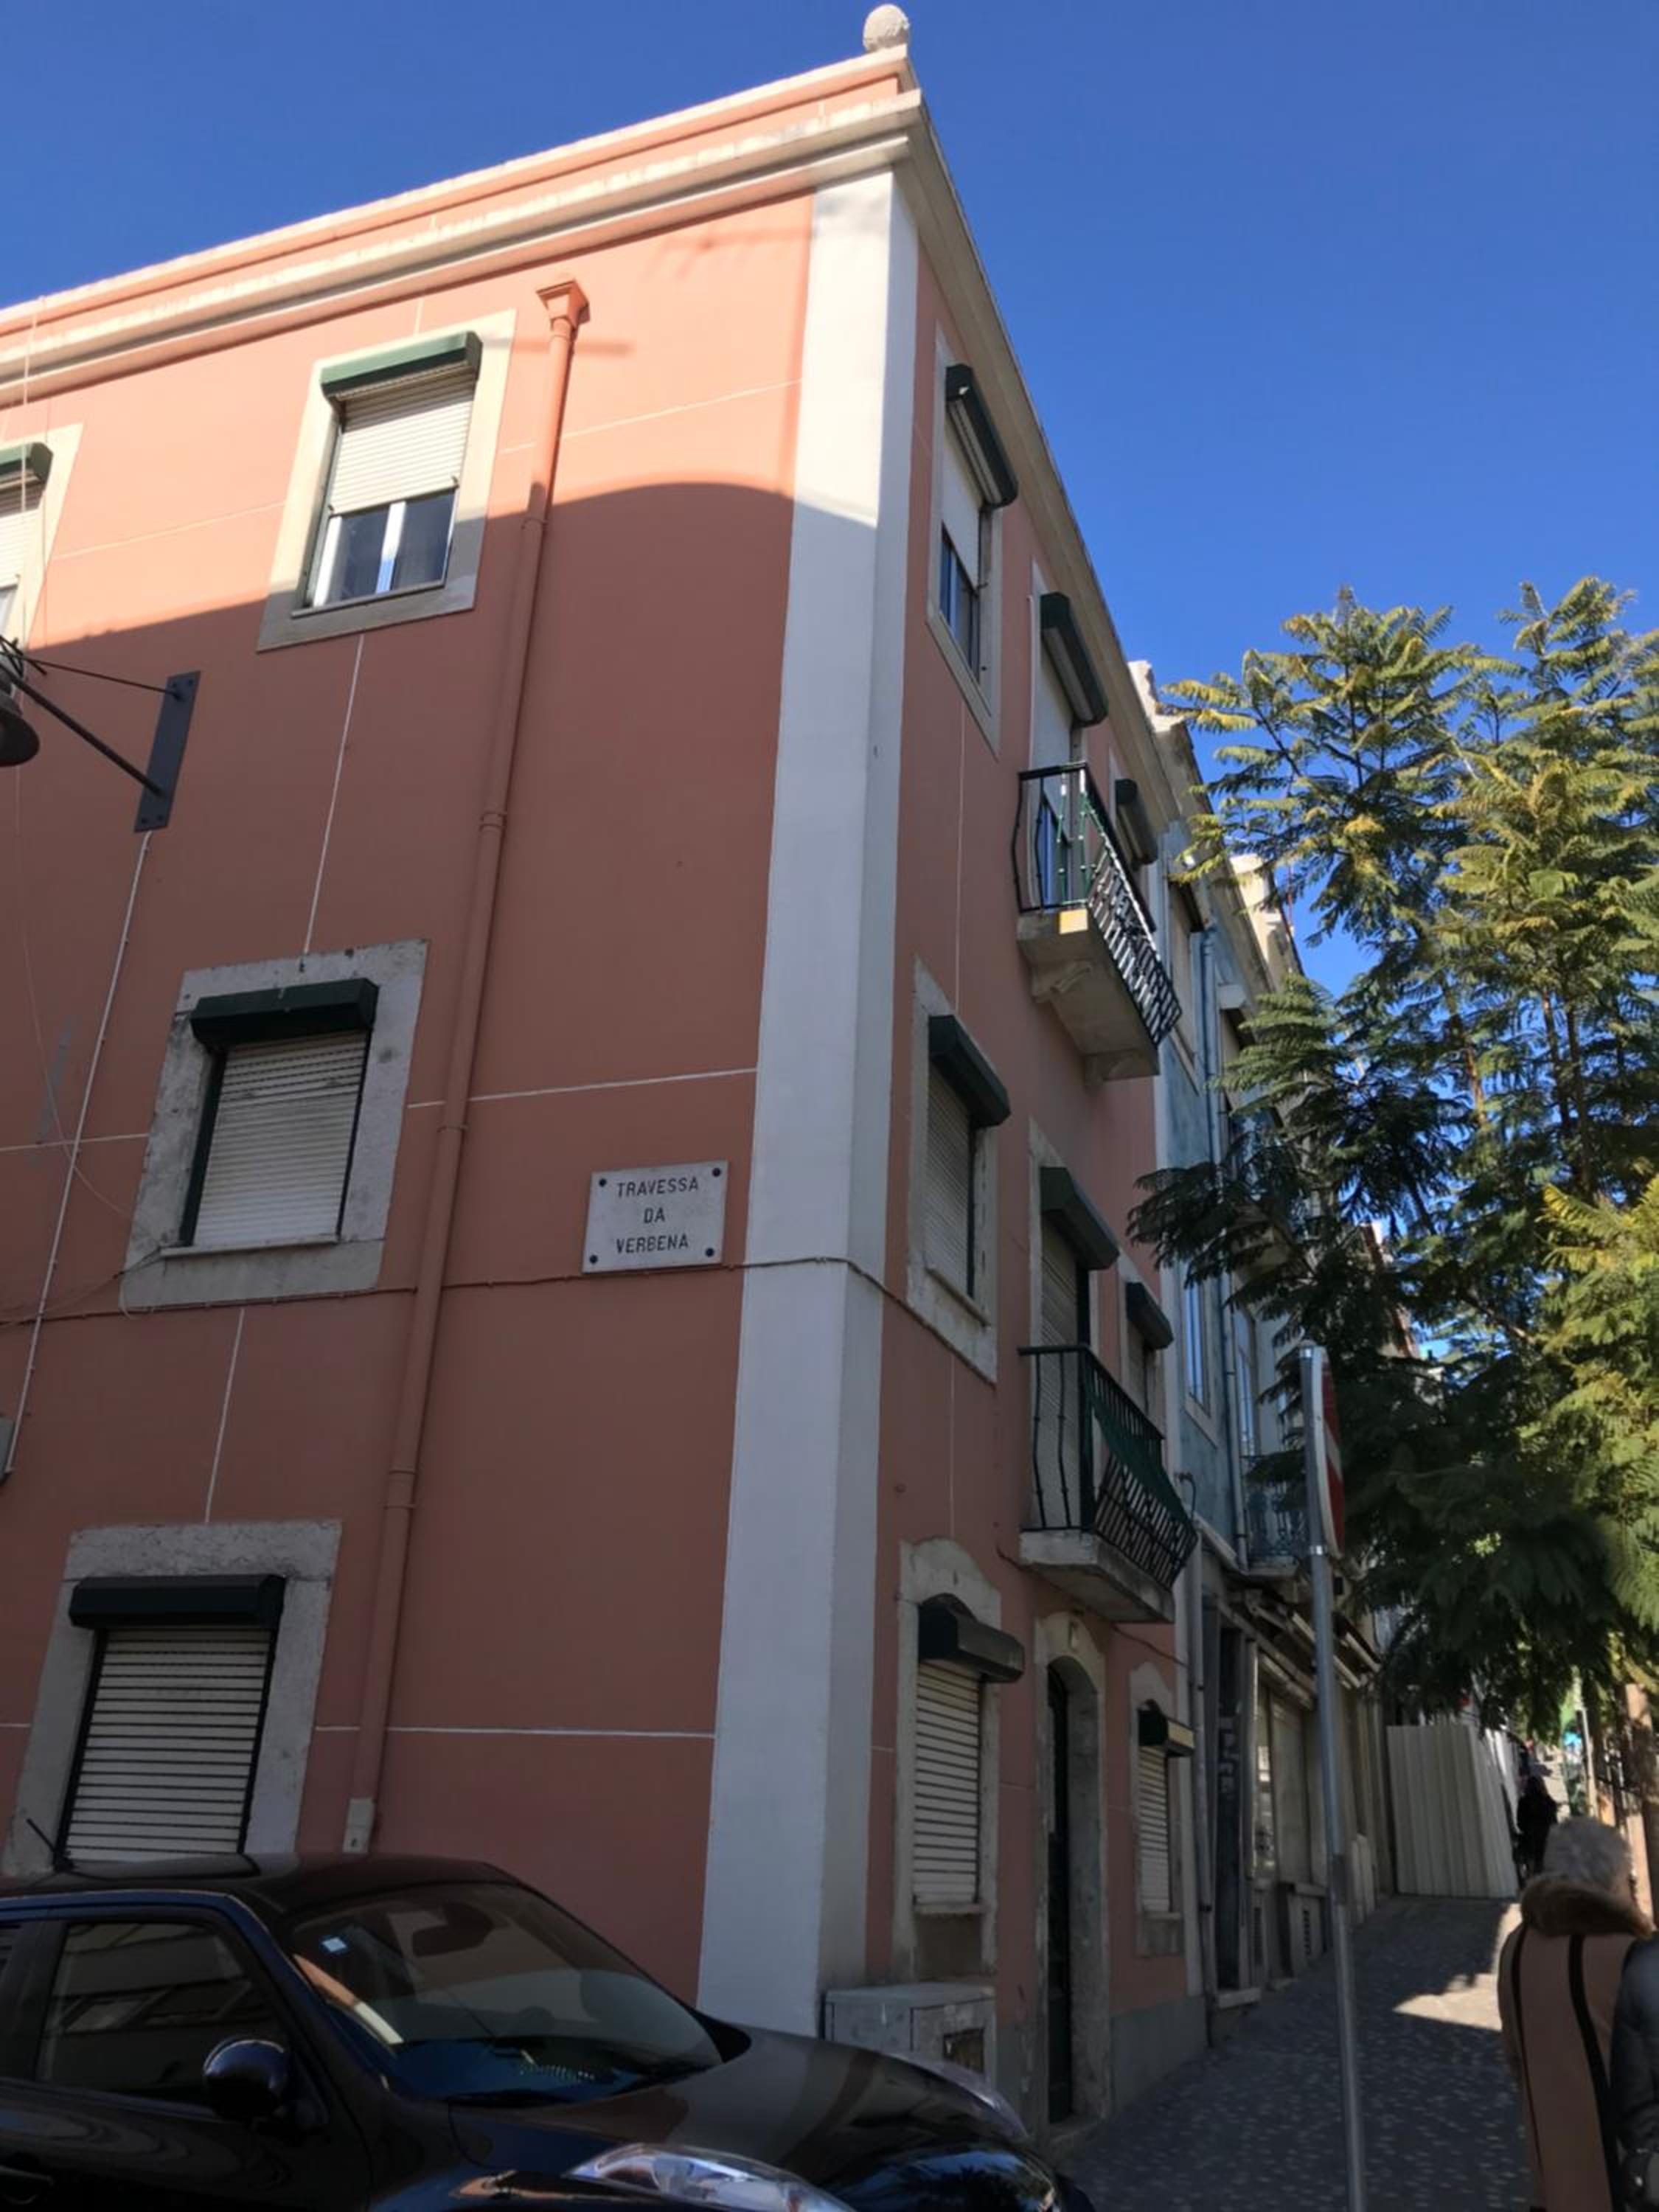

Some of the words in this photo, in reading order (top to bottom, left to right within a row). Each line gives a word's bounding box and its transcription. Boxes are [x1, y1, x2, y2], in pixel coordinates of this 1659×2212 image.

[617, 1177, 699, 1197] TRAVESSA
[643, 1207, 665, 1224] DA
[616, 1234, 689, 1254] VERBENA
